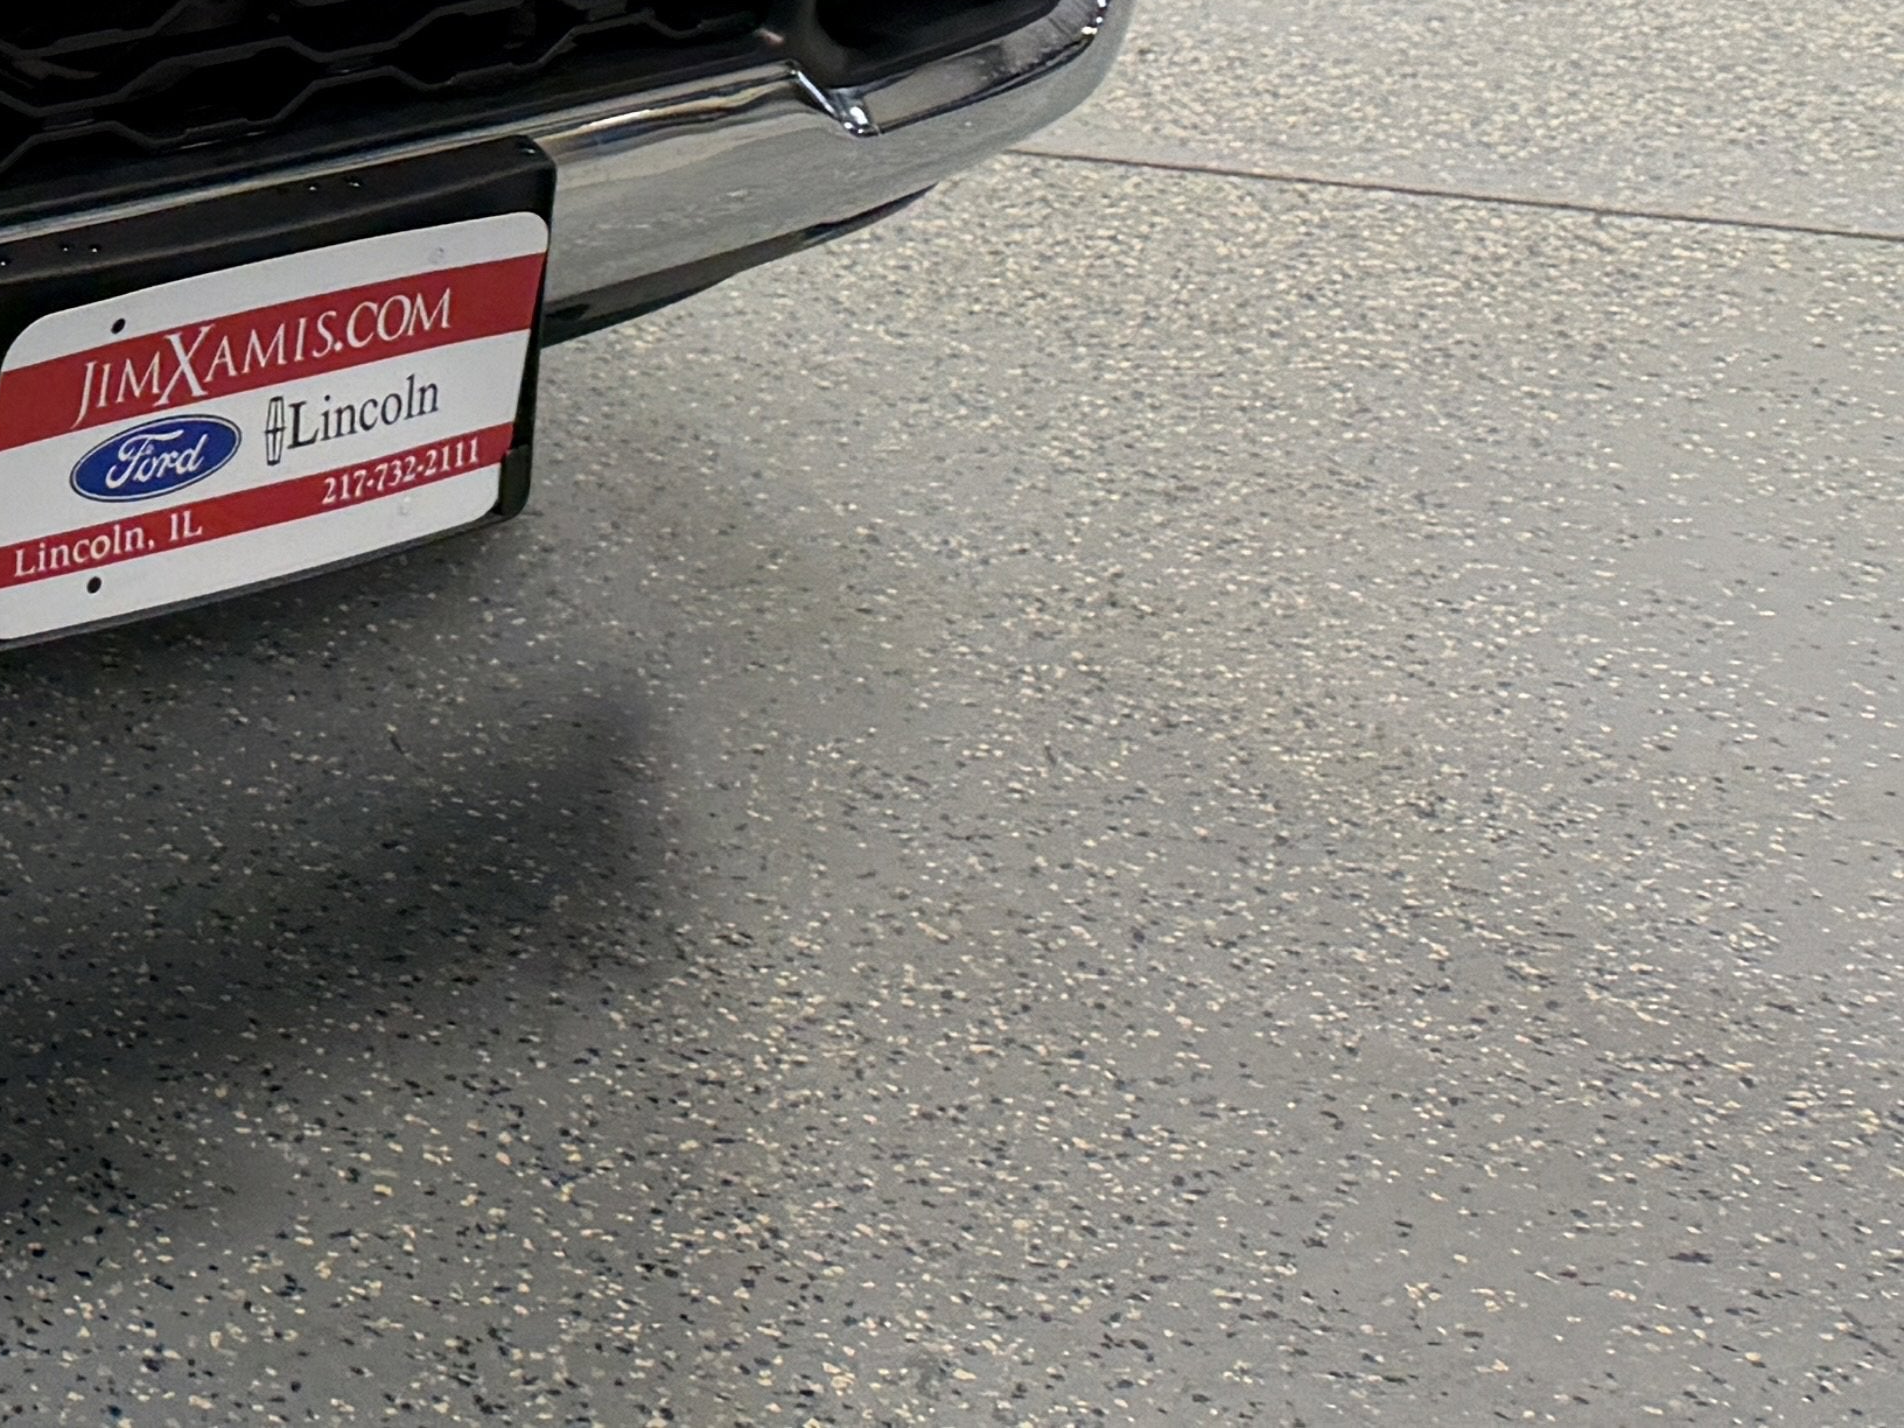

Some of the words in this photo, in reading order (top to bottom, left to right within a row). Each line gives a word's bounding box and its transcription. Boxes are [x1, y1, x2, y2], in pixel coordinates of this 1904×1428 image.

[70, 286, 453, 430] JIMXAMIS.COM
[286, 372, 441, 450] Lincoln
[104, 429, 209, 490] Ford
[321, 436, 480, 506] 217-732-2111
[12, 523, 156, 579] Lincoln,
[168, 510, 203, 542] IL
